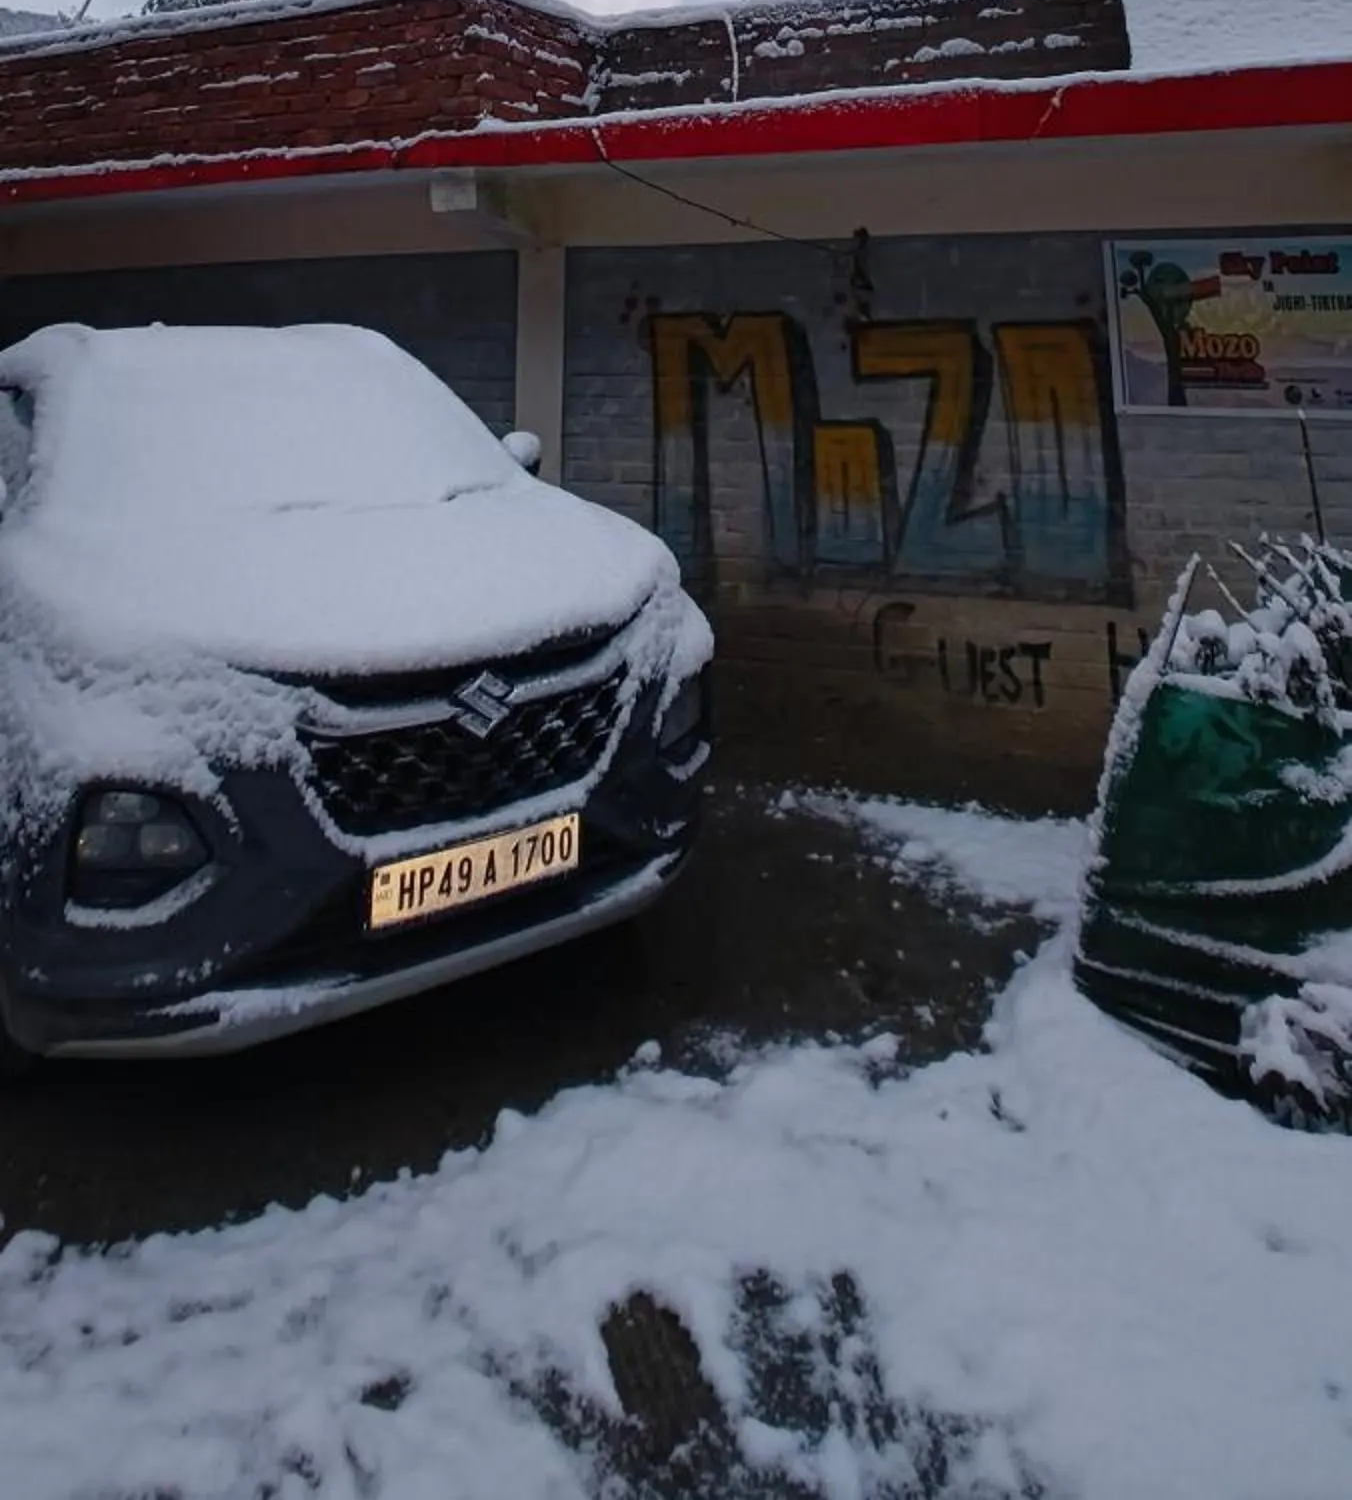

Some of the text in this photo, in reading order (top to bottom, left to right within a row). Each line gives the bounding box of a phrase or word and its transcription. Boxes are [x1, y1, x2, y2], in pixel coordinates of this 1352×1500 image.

[873, 601, 1052, 708] GUEST
[398, 826, 573, 911] HP49 A 1700
